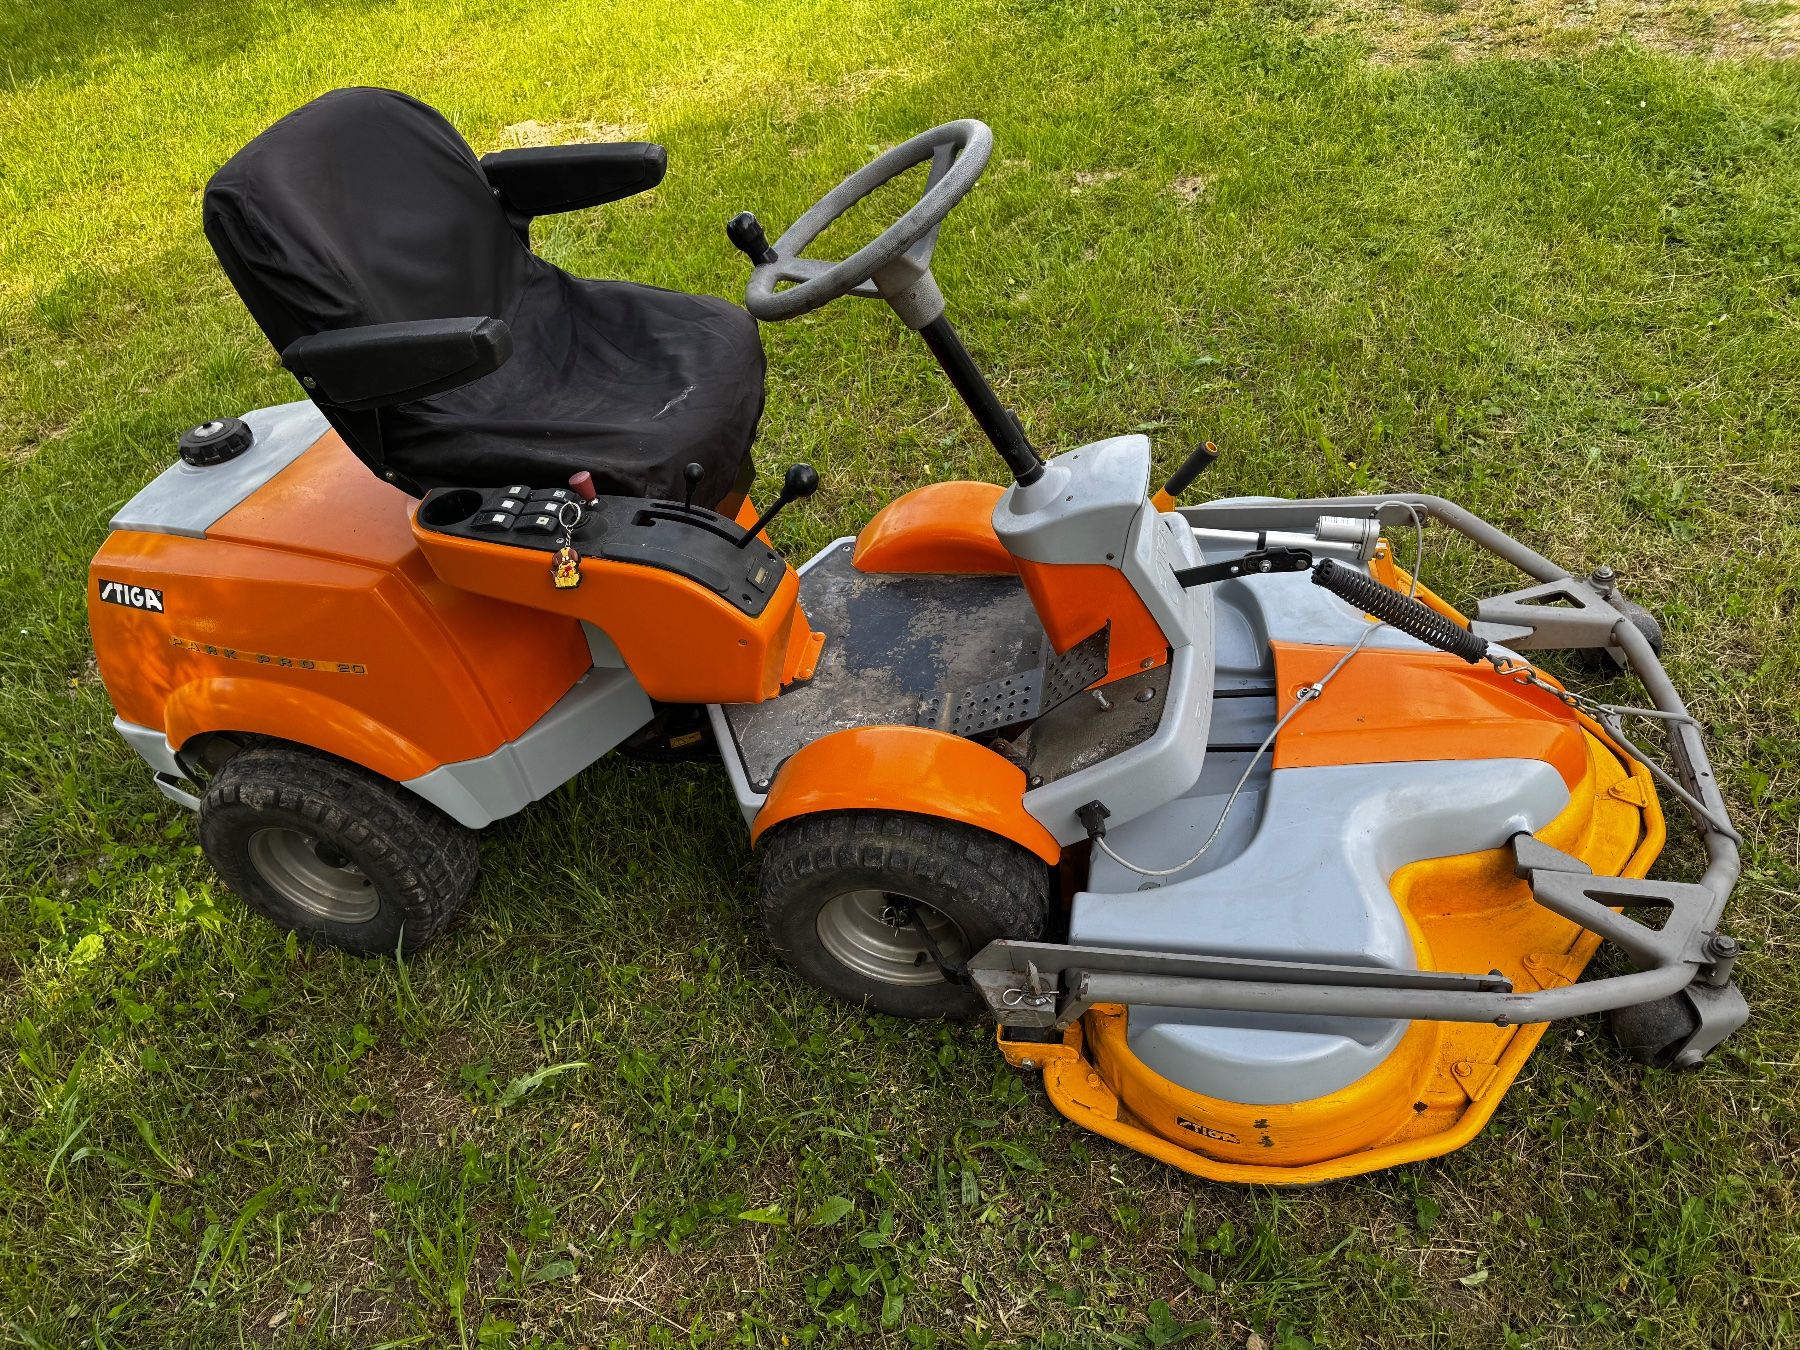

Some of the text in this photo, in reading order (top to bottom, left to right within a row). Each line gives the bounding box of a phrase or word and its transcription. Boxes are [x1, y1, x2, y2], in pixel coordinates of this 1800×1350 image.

[101, 582, 163, 611] STIGA
[170, 637, 365, 674] PARK PRO 20
